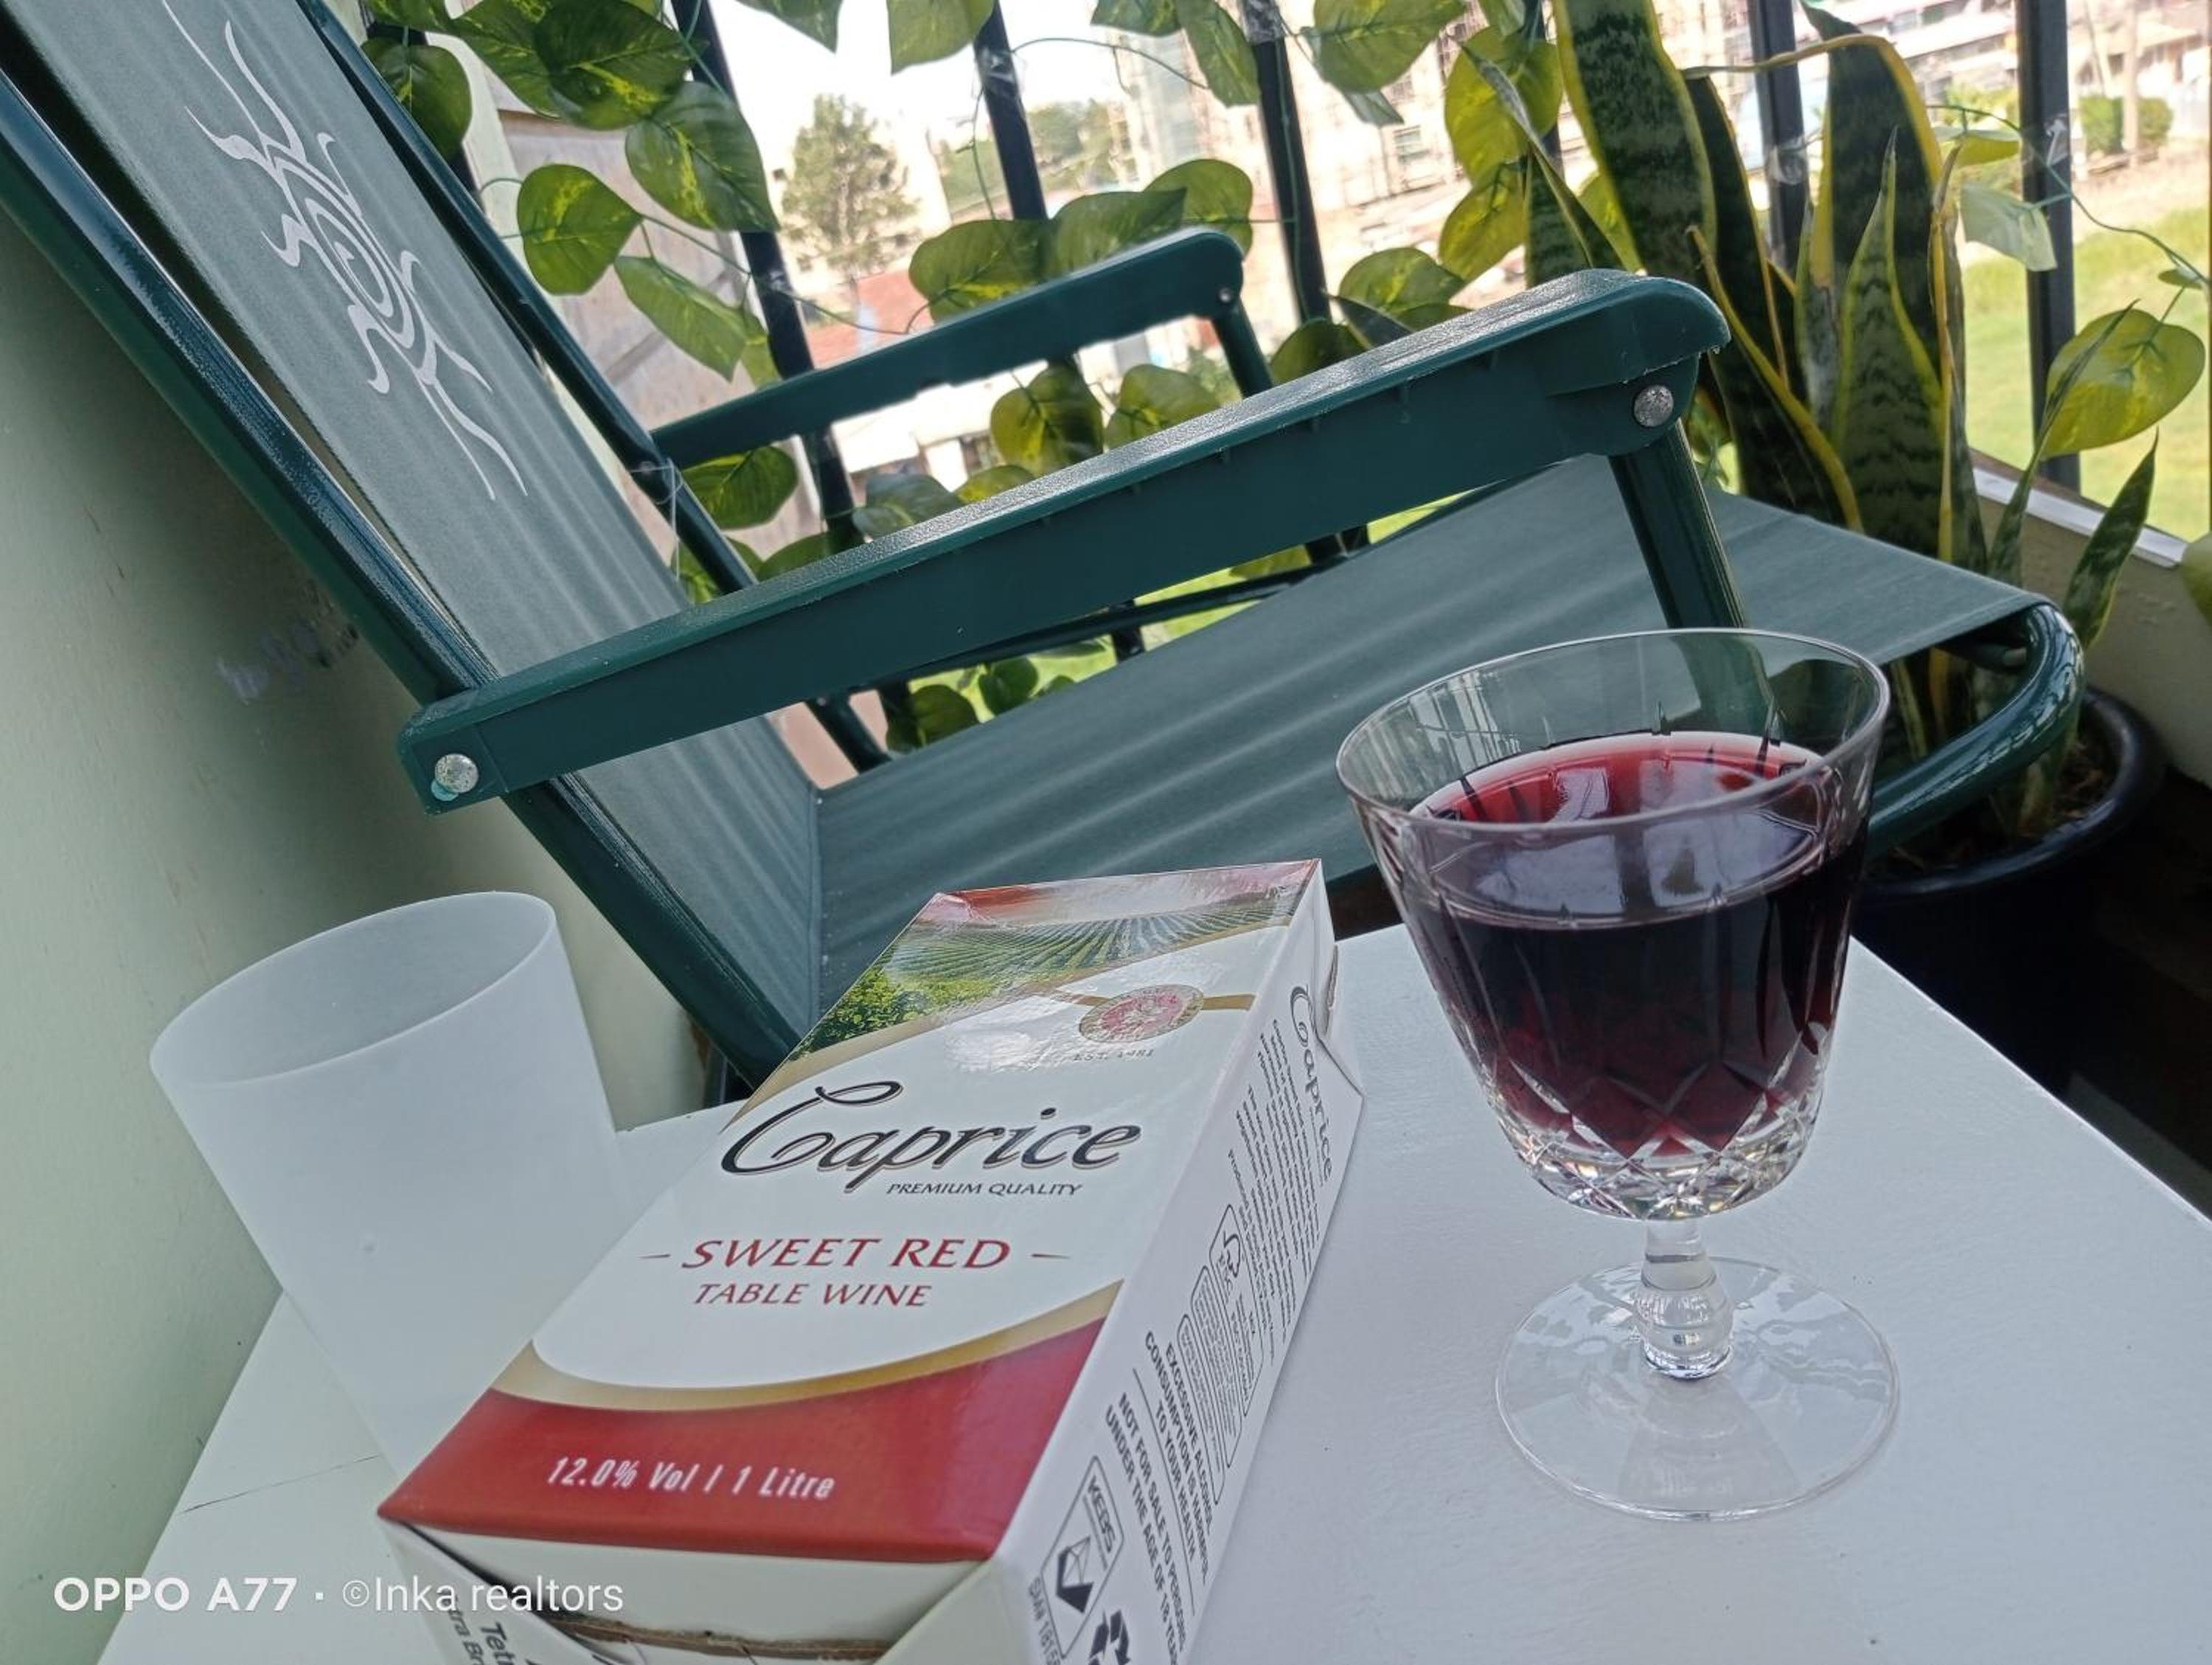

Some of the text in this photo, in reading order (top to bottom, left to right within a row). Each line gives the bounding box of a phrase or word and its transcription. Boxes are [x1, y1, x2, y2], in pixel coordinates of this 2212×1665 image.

[720, 1080, 1142, 1193] Caprice
[886, 1183, 1083, 1197] PREMIUM QUALITY
[681, 1238, 1011, 1269] SWEET RED
[693, 1282, 933, 1307] TABLE WINE
[1145, 1330, 1192, 1475] CONSUMPTION
[1165, 1342, 1199, 1450] EXCESSIVE
[546, 1456, 638, 1489] 12.0%
[648, 1461, 695, 1490] Vol
[731, 1466, 747, 1495] 1
[759, 1469, 838, 1501] Litre
[1086, 1474, 1117, 1554] KEBS
[1105, 1405, 1135, 1483] UNDER
[1132, 1477, 1148, 1526] THE
[1142, 1522, 1159, 1568] AGE
[1153, 1563, 1165, 1591] OF
[1119, 1391, 1141, 1439] NOT
[1135, 1436, 1152, 1485] FOR
[1148, 1481, 1166, 1537] SALE
[1161, 1531, 1172, 1566] TO
[1155, 1400, 1196, 1562] TO YOUR HEALTH
